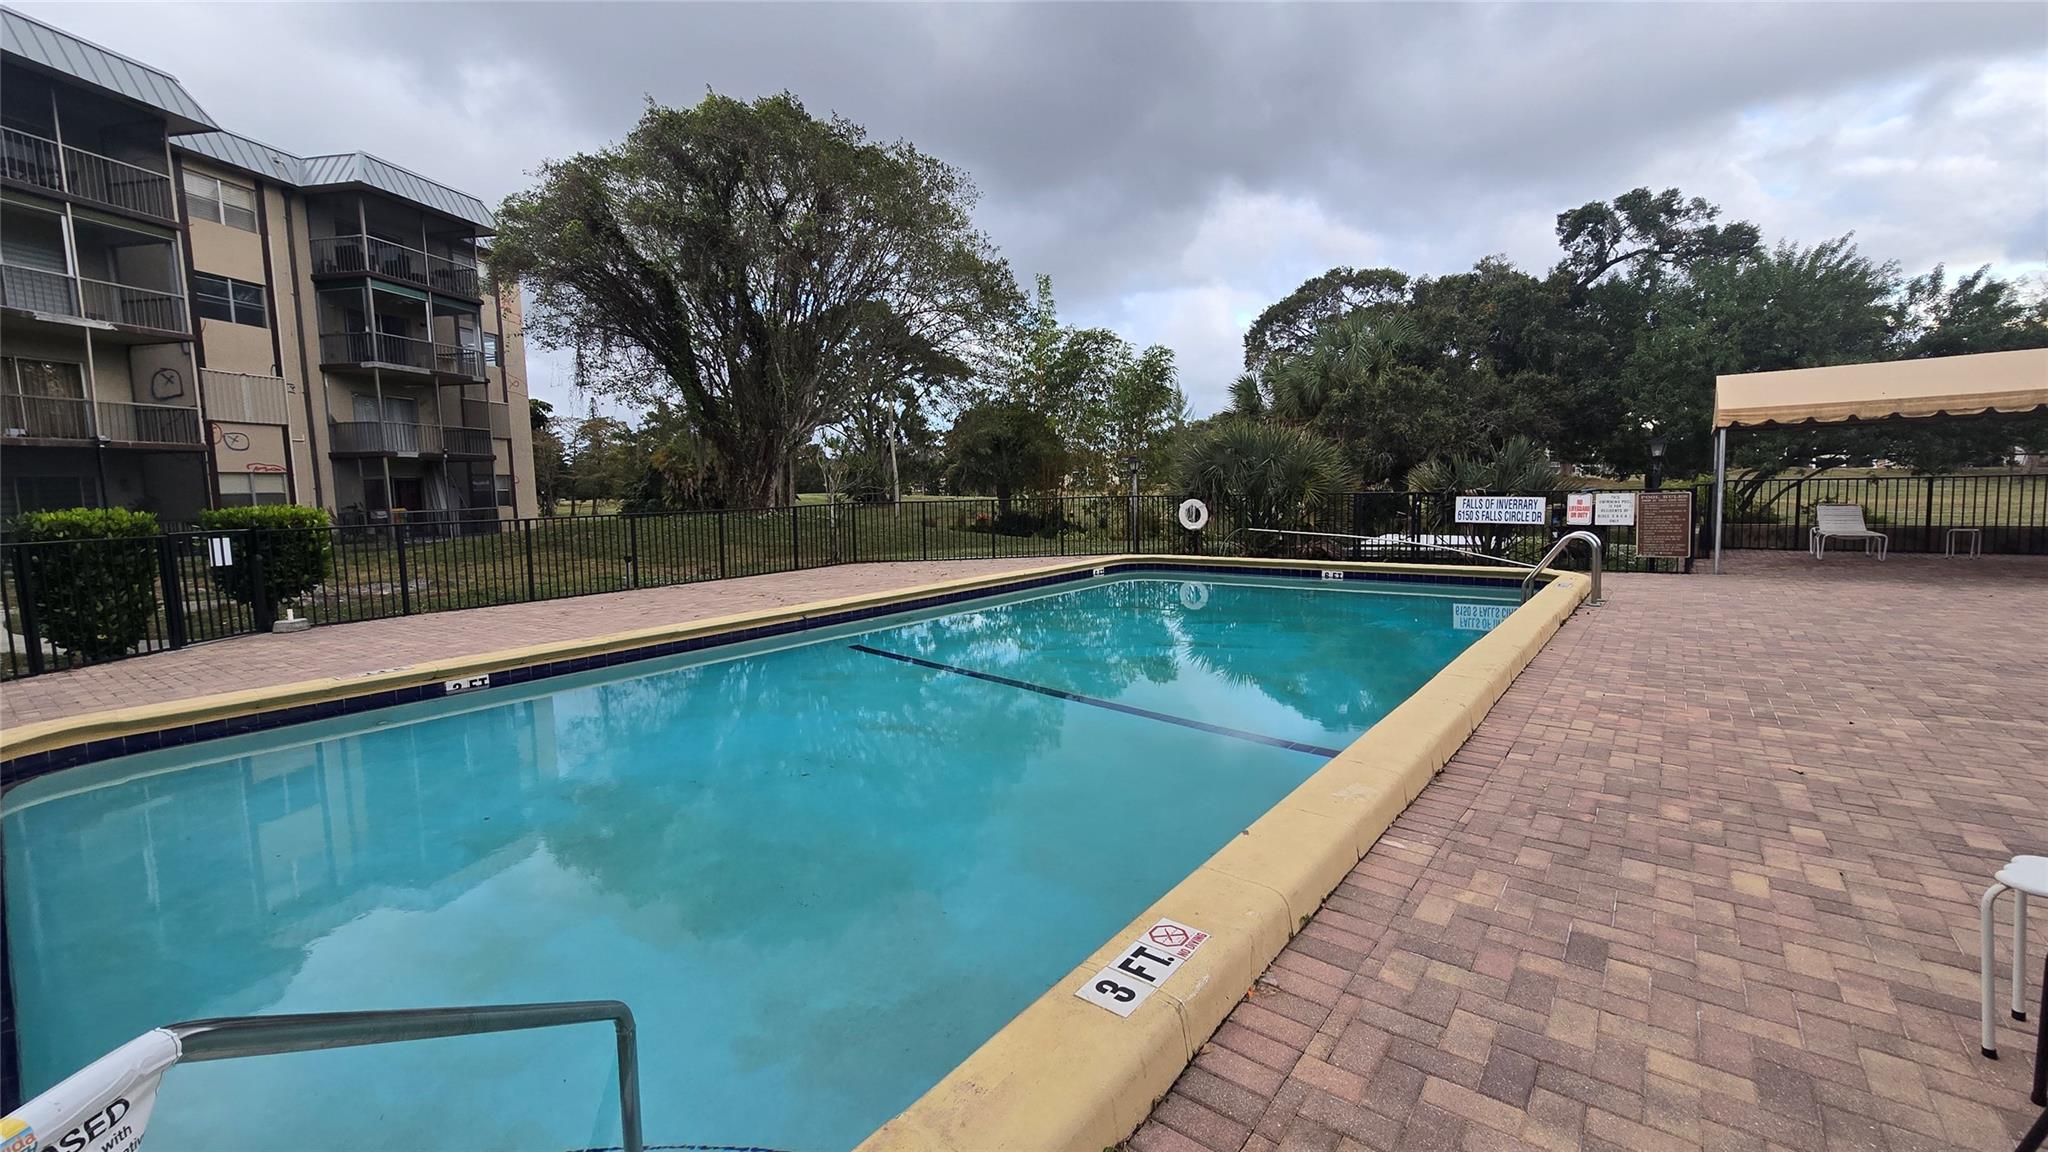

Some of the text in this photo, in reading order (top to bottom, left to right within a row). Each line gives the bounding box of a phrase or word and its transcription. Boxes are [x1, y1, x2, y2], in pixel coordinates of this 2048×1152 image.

[1457, 510, 1542, 522] 6150 S FALLS CIRCLE DR
[1462, 498, 1538, 510] FALLS OF INVERRARY
[1177, 932, 1207, 958] NO DIVING
[1095, 945, 1175, 1003] 3 FT.
[101, 1125, 132, 1152] with
